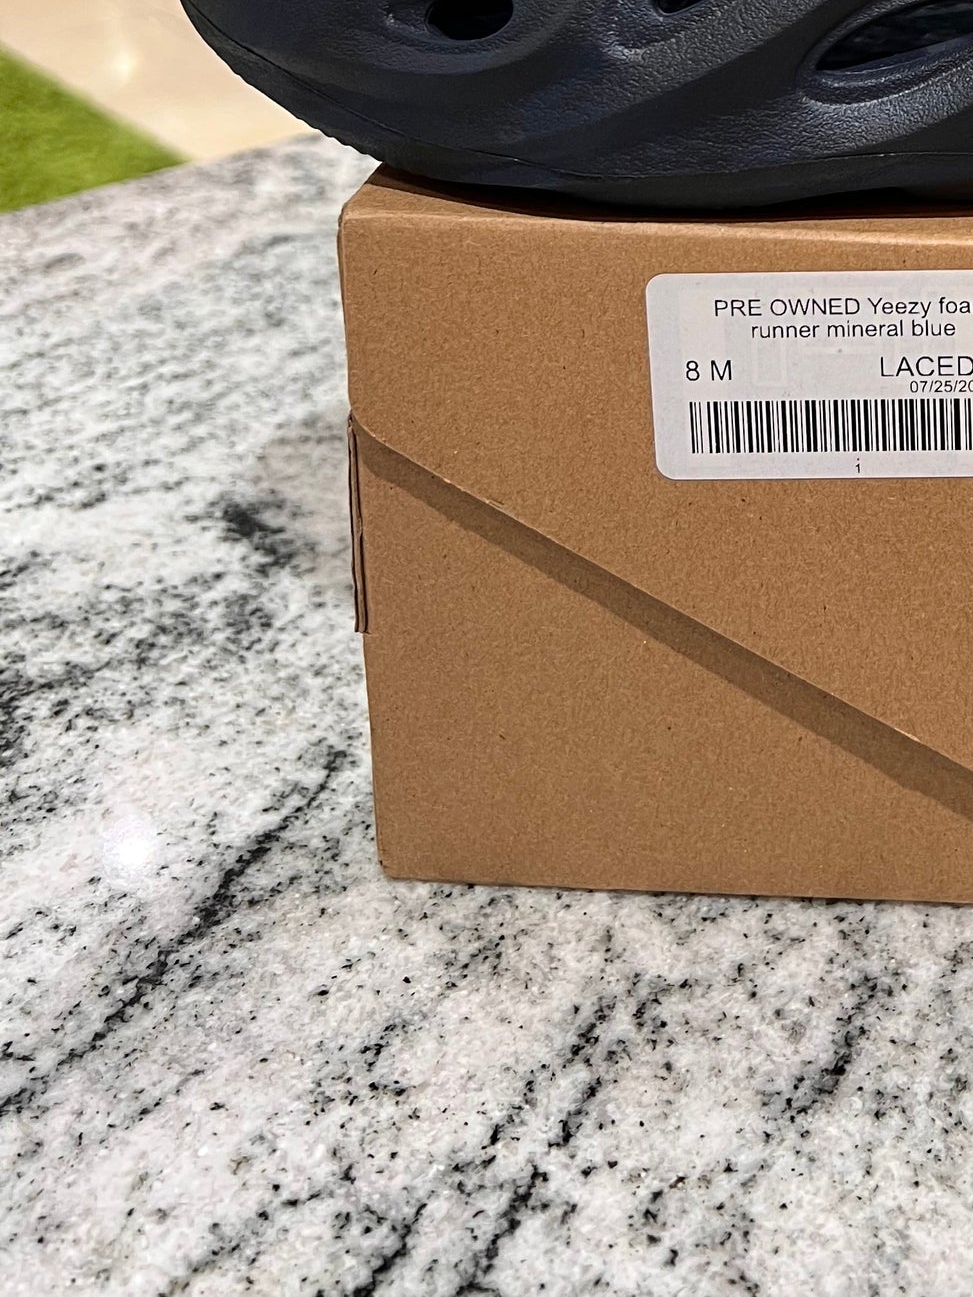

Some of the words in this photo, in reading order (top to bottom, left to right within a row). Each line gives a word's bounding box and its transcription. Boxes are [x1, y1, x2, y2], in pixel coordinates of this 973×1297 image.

[714, 299, 763, 317] PRE
[769, 297, 860, 317] OWNED
[867, 297, 932, 319] Yeezy
[751, 322, 820, 339] runner
[827, 320, 904, 338] mineral
[912, 319, 956, 337] blue
[685, 360, 701, 381] 8
[710, 359, 733, 381] M
